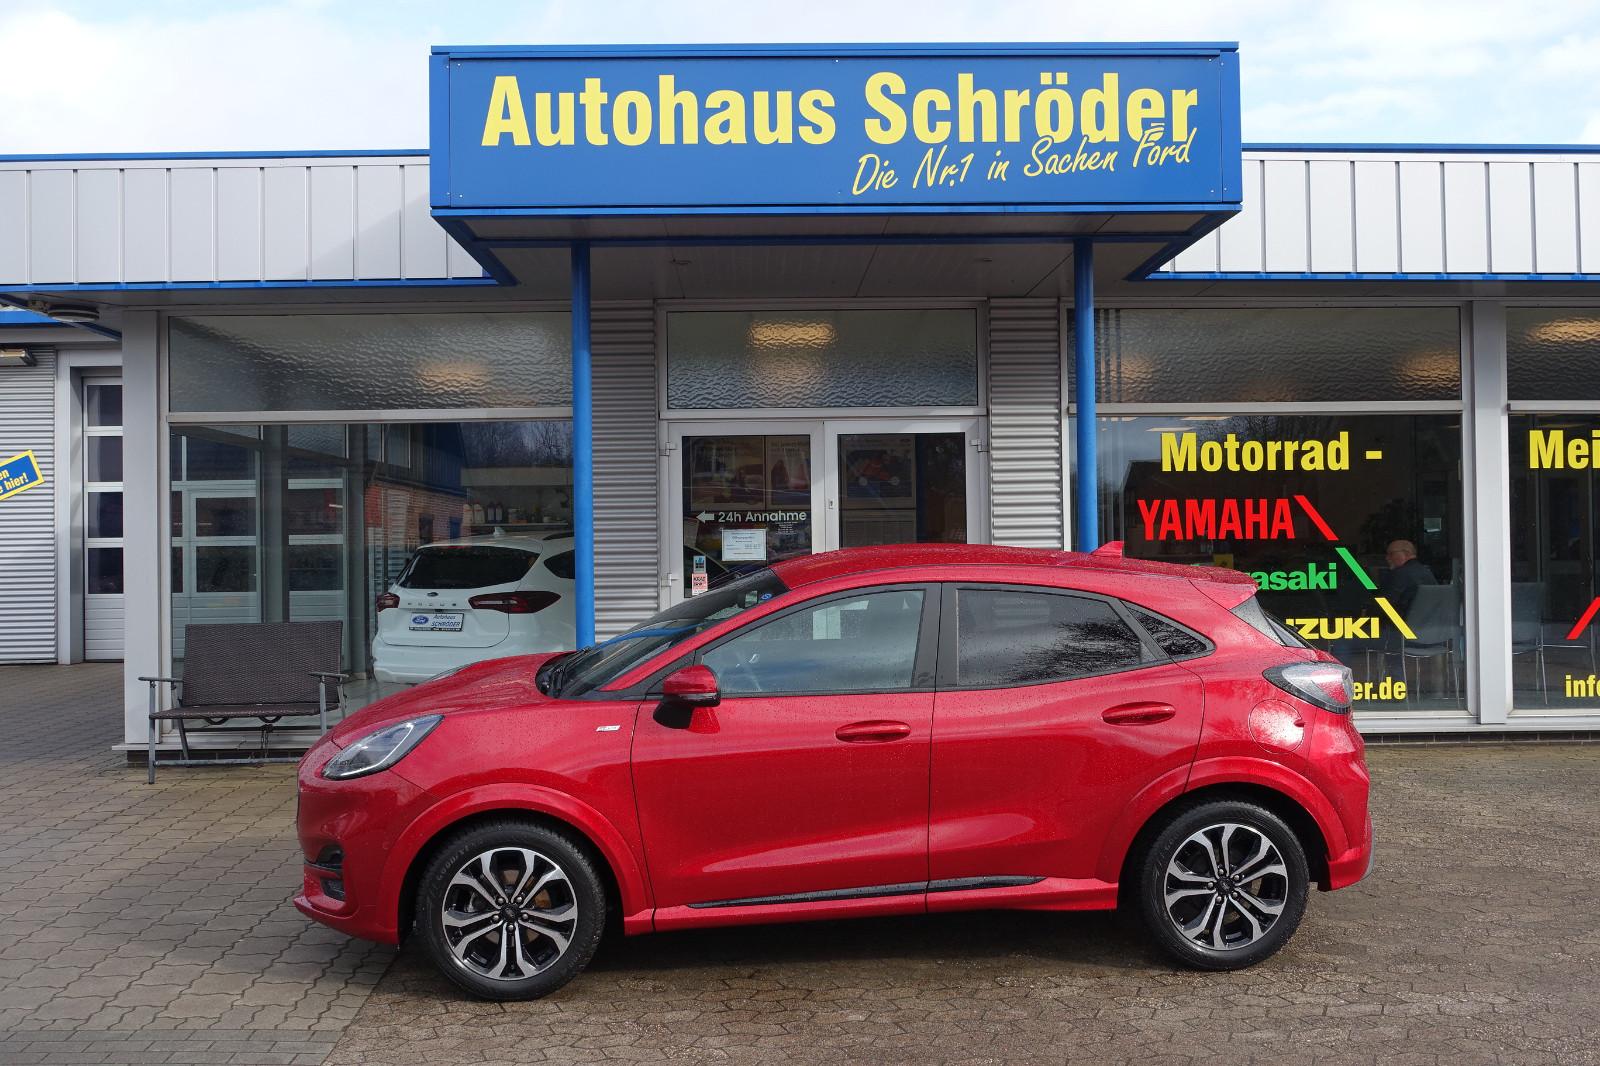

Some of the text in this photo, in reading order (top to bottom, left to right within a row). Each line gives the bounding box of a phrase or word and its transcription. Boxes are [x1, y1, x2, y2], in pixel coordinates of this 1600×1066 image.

[481, 71, 1198, 147] Autohaus Schröder
[852, 123, 1198, 196] Die Nr.1 in Sachen Ford
[1161, 431, 1350, 472] Motorrad
[1529, 429, 1600, 469] Mei
[4, 472, 29, 490] hier!
[718, 510, 807, 523] 24h Annahme
[1137, 499, 1295, 541] YAMAHA
[1247, 562, 1338, 591] asaki
[1286, 617, 1380, 640] ZUKI
